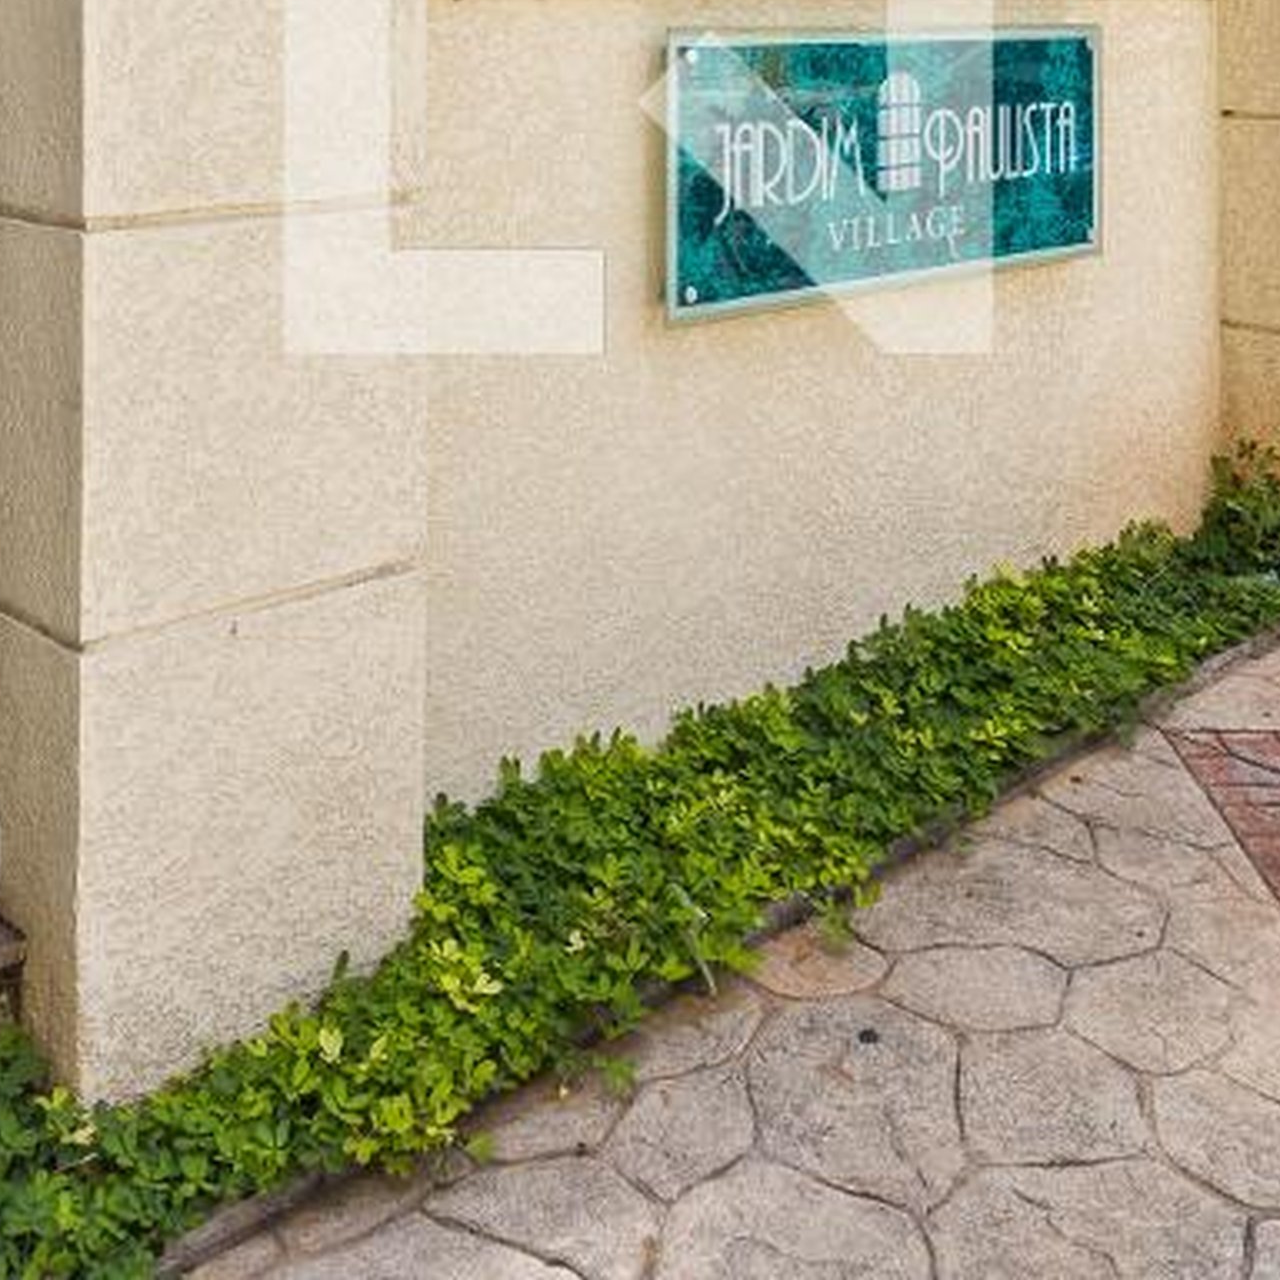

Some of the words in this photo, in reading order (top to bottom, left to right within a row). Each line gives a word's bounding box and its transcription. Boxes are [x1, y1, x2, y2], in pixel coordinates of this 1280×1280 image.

[714, 116, 865, 225] JARDIM
[923, 102, 1076, 198] PAULISTA
[827, 206, 966, 254] VILLAGE
